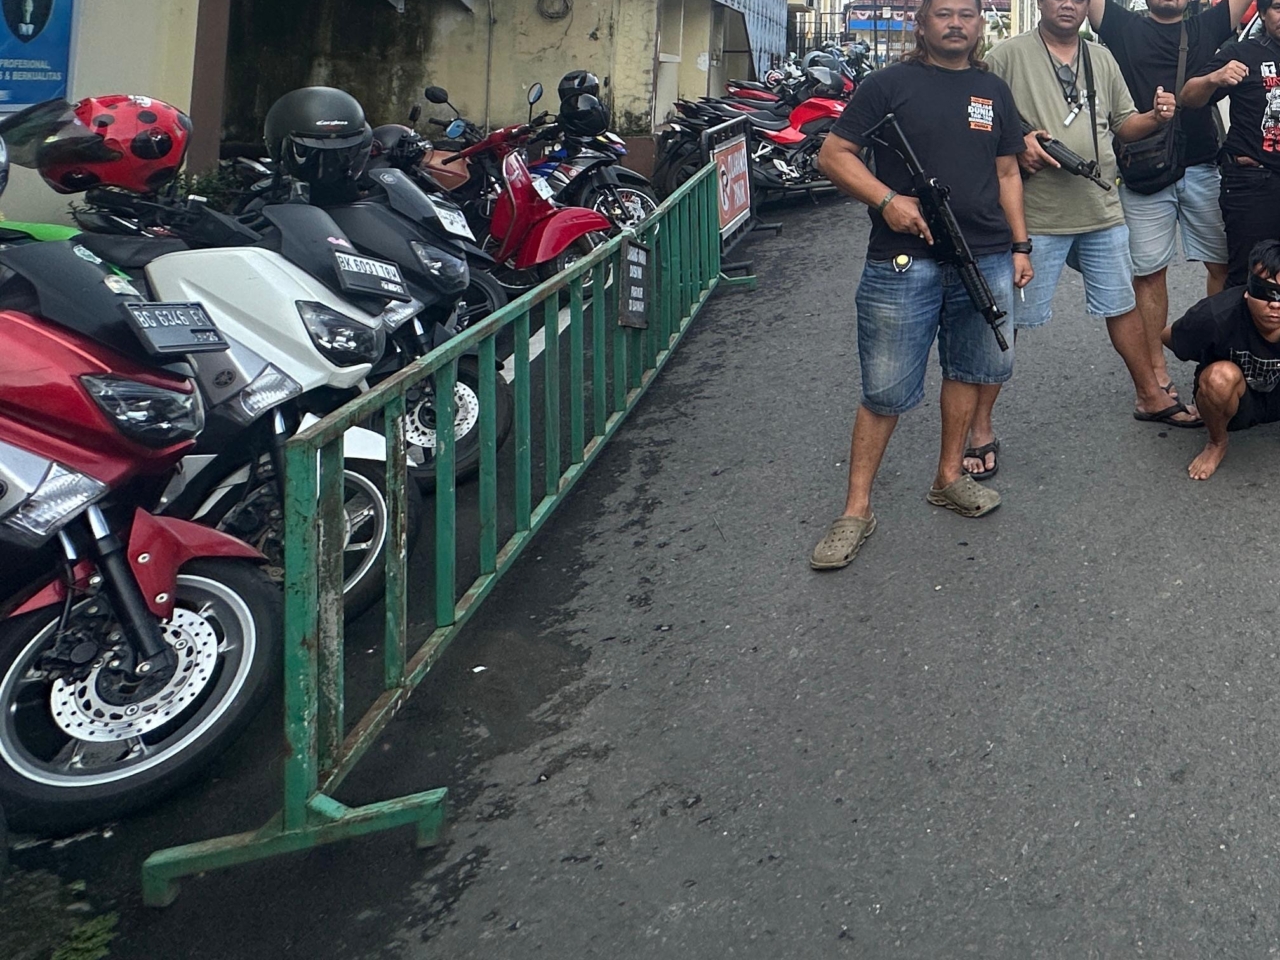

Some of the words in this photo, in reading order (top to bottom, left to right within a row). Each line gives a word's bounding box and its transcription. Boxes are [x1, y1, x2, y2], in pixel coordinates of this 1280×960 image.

[968, 105, 994, 118] DUNIA
[133, 310, 157, 328] BG
[155, 310, 189, 326] 6346
